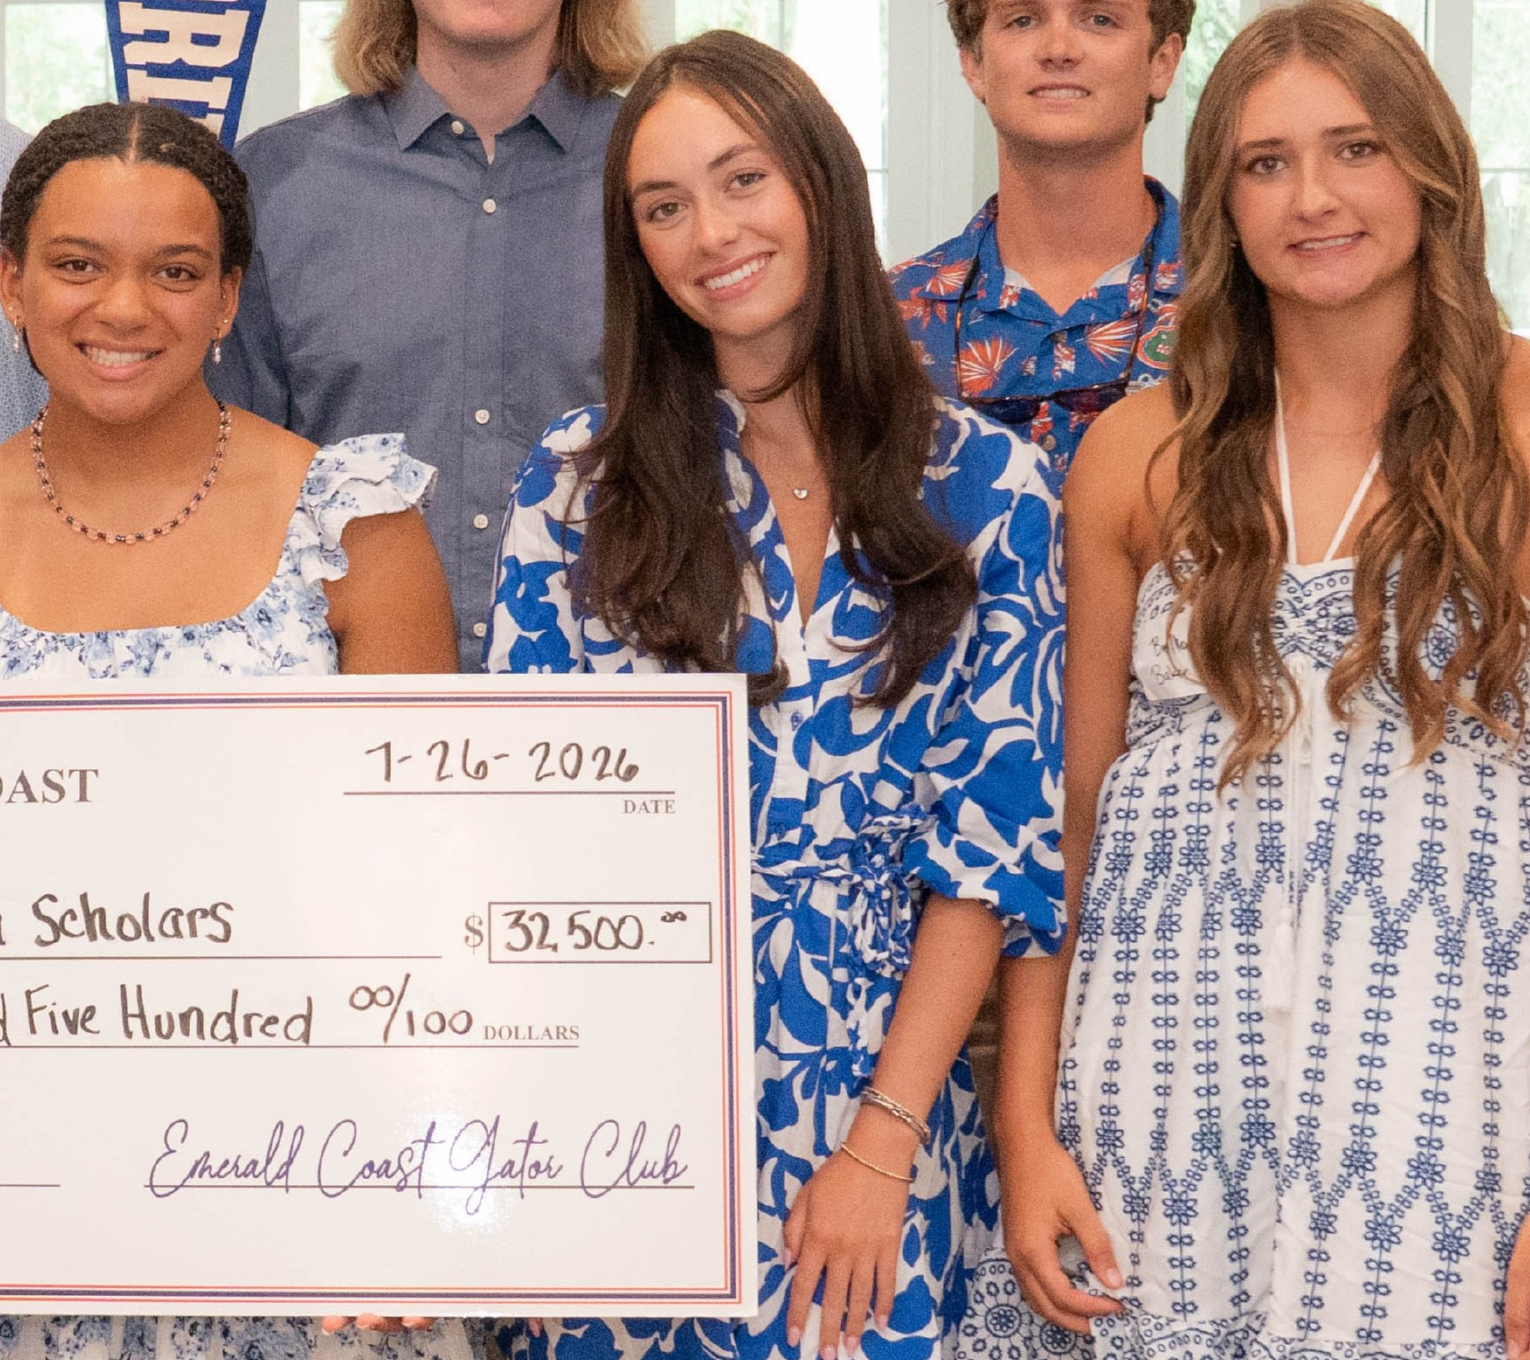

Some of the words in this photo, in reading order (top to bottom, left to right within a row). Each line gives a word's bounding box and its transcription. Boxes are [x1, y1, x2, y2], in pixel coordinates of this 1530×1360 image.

[622, 798, 676, 815] DATE
[31, 891, 235, 948] Scholars
[463, 912, 484, 955] $
[24, 984, 101, 1036] Five
[119, 983, 314, 1045] Hundred
[483, 1024, 581, 1041] DOLLARS
[149, 1118, 306, 1199] Emerald
[317, 1118, 446, 1200] Coast
[448, 1114, 564, 1216] Gator
[580, 1118, 690, 1199] Club
